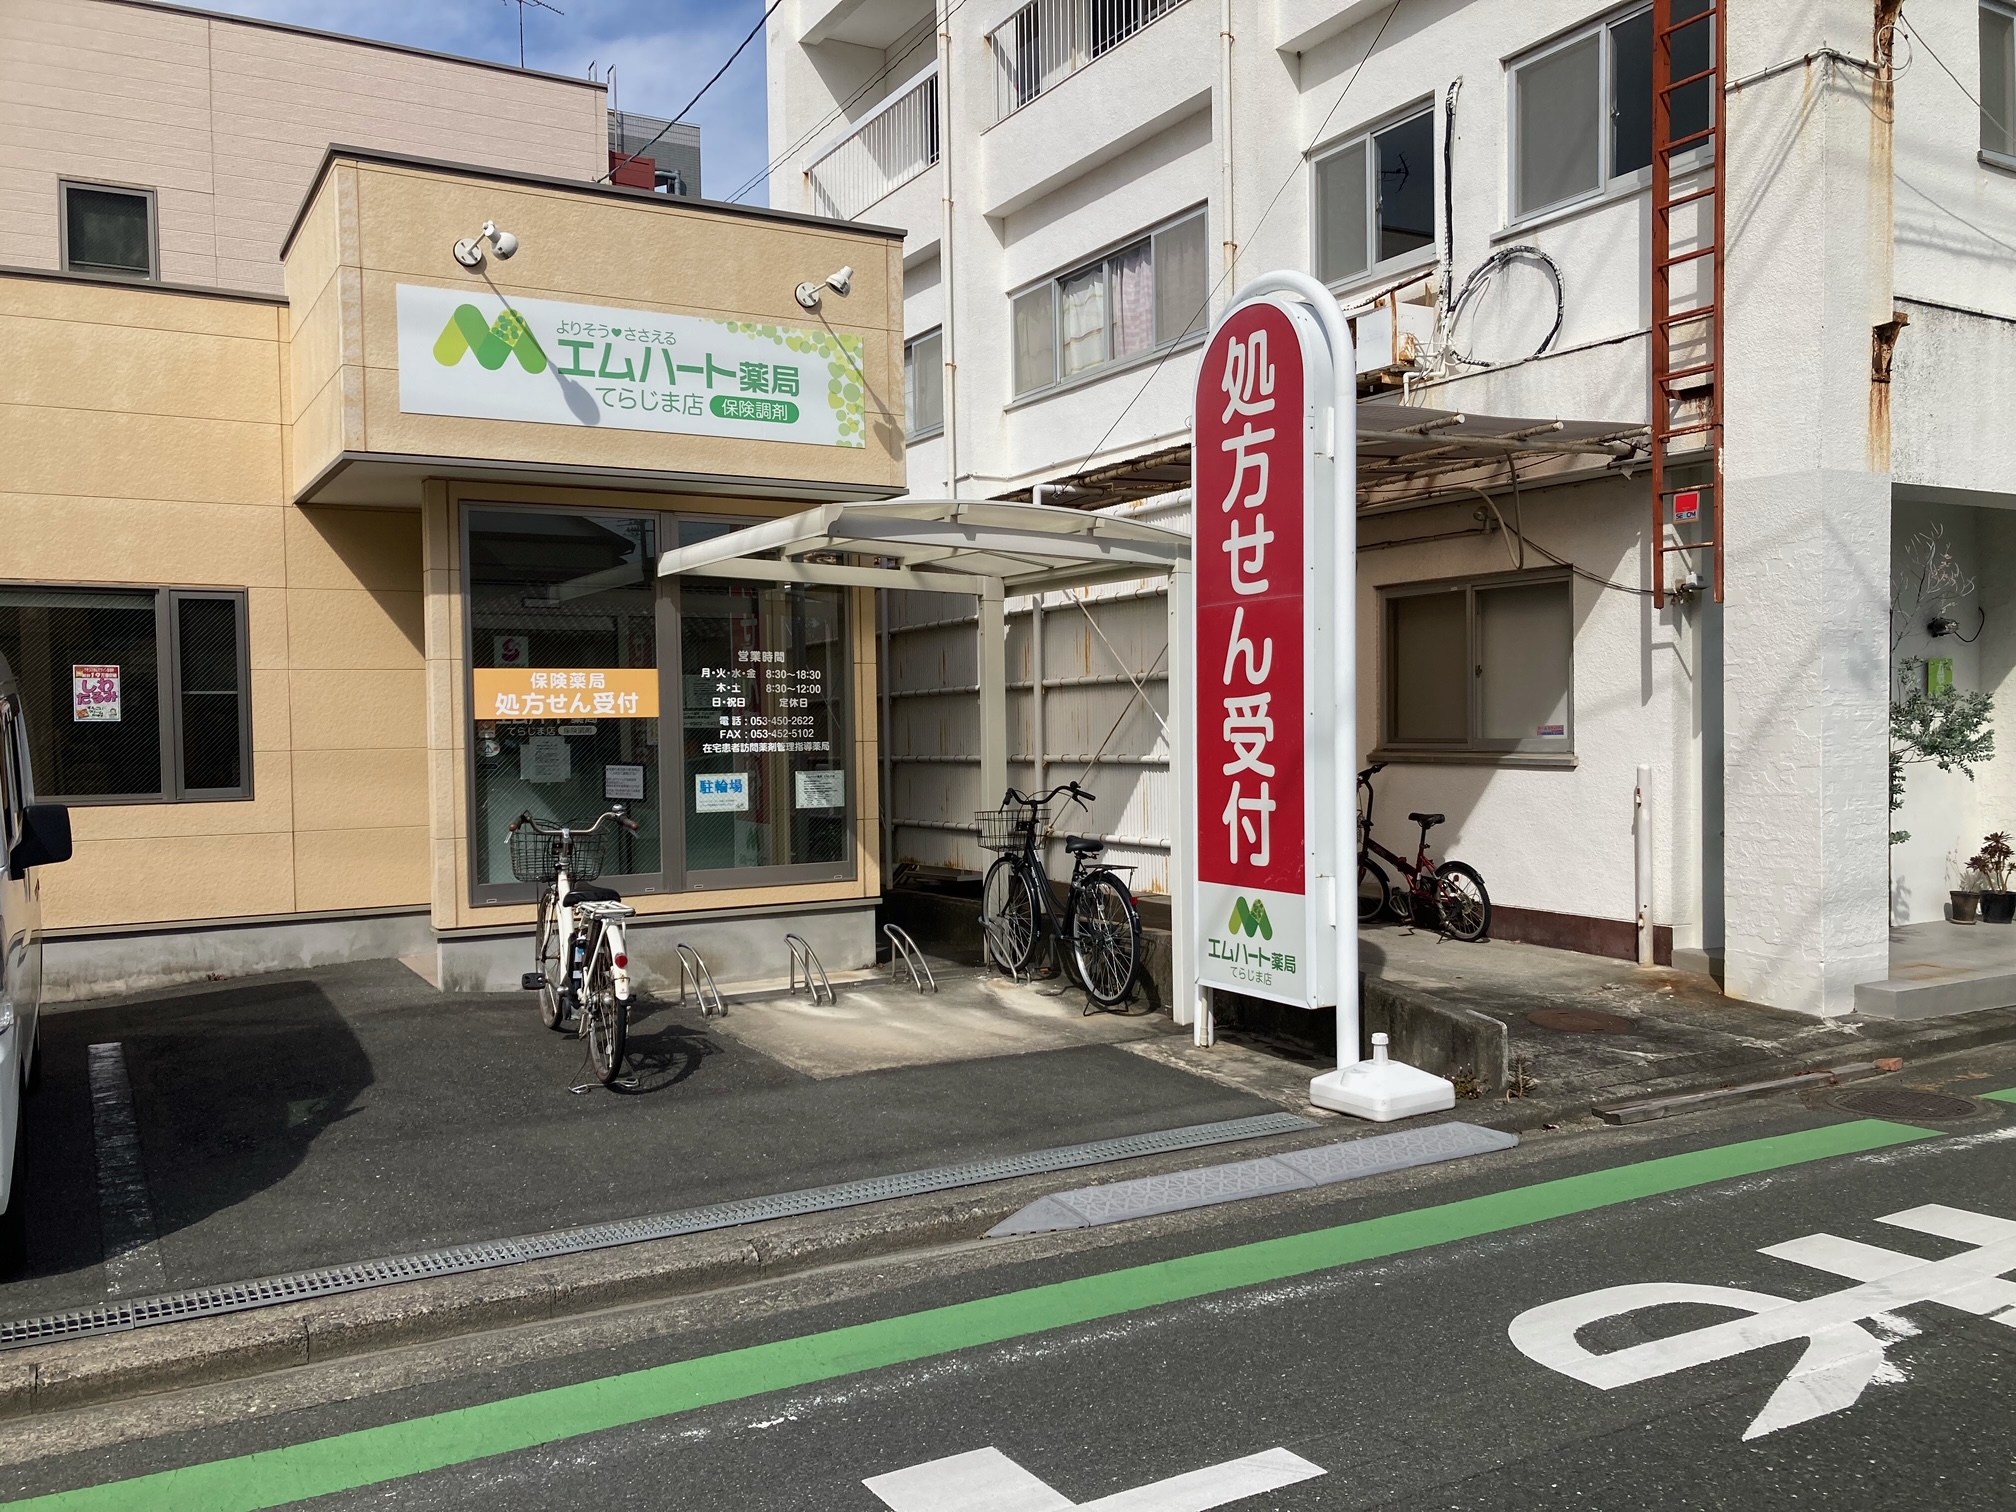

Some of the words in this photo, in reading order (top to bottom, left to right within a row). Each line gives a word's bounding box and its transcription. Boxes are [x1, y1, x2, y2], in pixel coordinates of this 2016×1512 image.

[557, 338, 801, 396] エムハート薬局
[595, 387, 704, 417] てらじま店
[721, 398, 789, 421] 保険調剤
[1220, 327, 1277, 868] 処方せん受付
[737, 650, 785, 663] 営業時間
[81, 677, 115, 693] しわ
[530, 671, 606, 689] 保険薬局
[495, 691, 640, 716] 処方せん受付
[779, 697, 809, 708] 定休日
[702, 741, 830, 753] 在宅患者訪問薬剤管理指導薬局
[699, 778, 744, 795] 駐輪場
[1208, 937, 1297, 975] エムハート薬局
[1229, 965, 1273, 986] てらじま店
